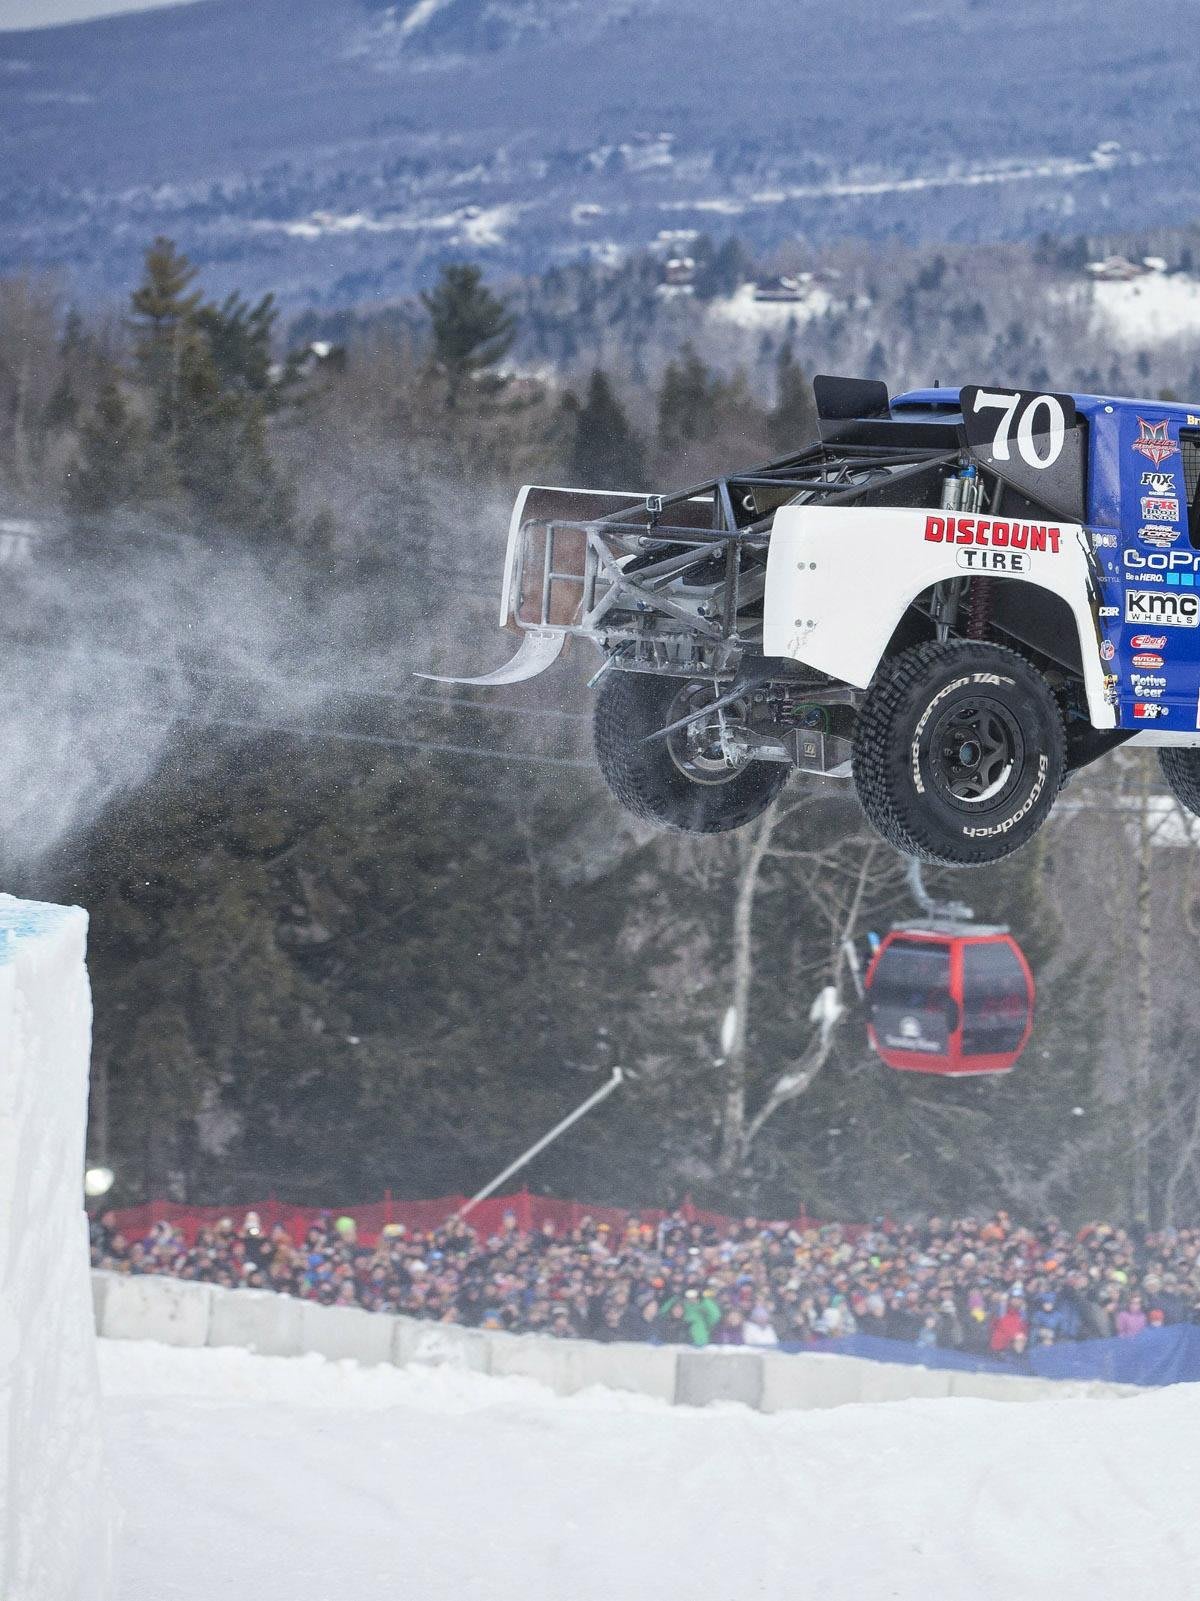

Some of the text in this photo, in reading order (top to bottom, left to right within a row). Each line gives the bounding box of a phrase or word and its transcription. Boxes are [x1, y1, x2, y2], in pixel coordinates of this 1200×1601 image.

[973, 389, 1065, 469] 70
[1142, 472, 1173, 486] FOX
[1146, 500, 1177, 510] FK
[924, 516, 1060, 553] DISCOUNT
[964, 550, 1023, 571] TIRE
[1125, 572, 1135, 581] Be
[1140, 573, 1164, 582] HERO.
[1131, 613, 1193, 624] WHEELS
[1130, 674, 1167, 687] Motive
[1134, 686, 1162, 698] Gear
[962, 754, 1049, 838] BFGoodrich
